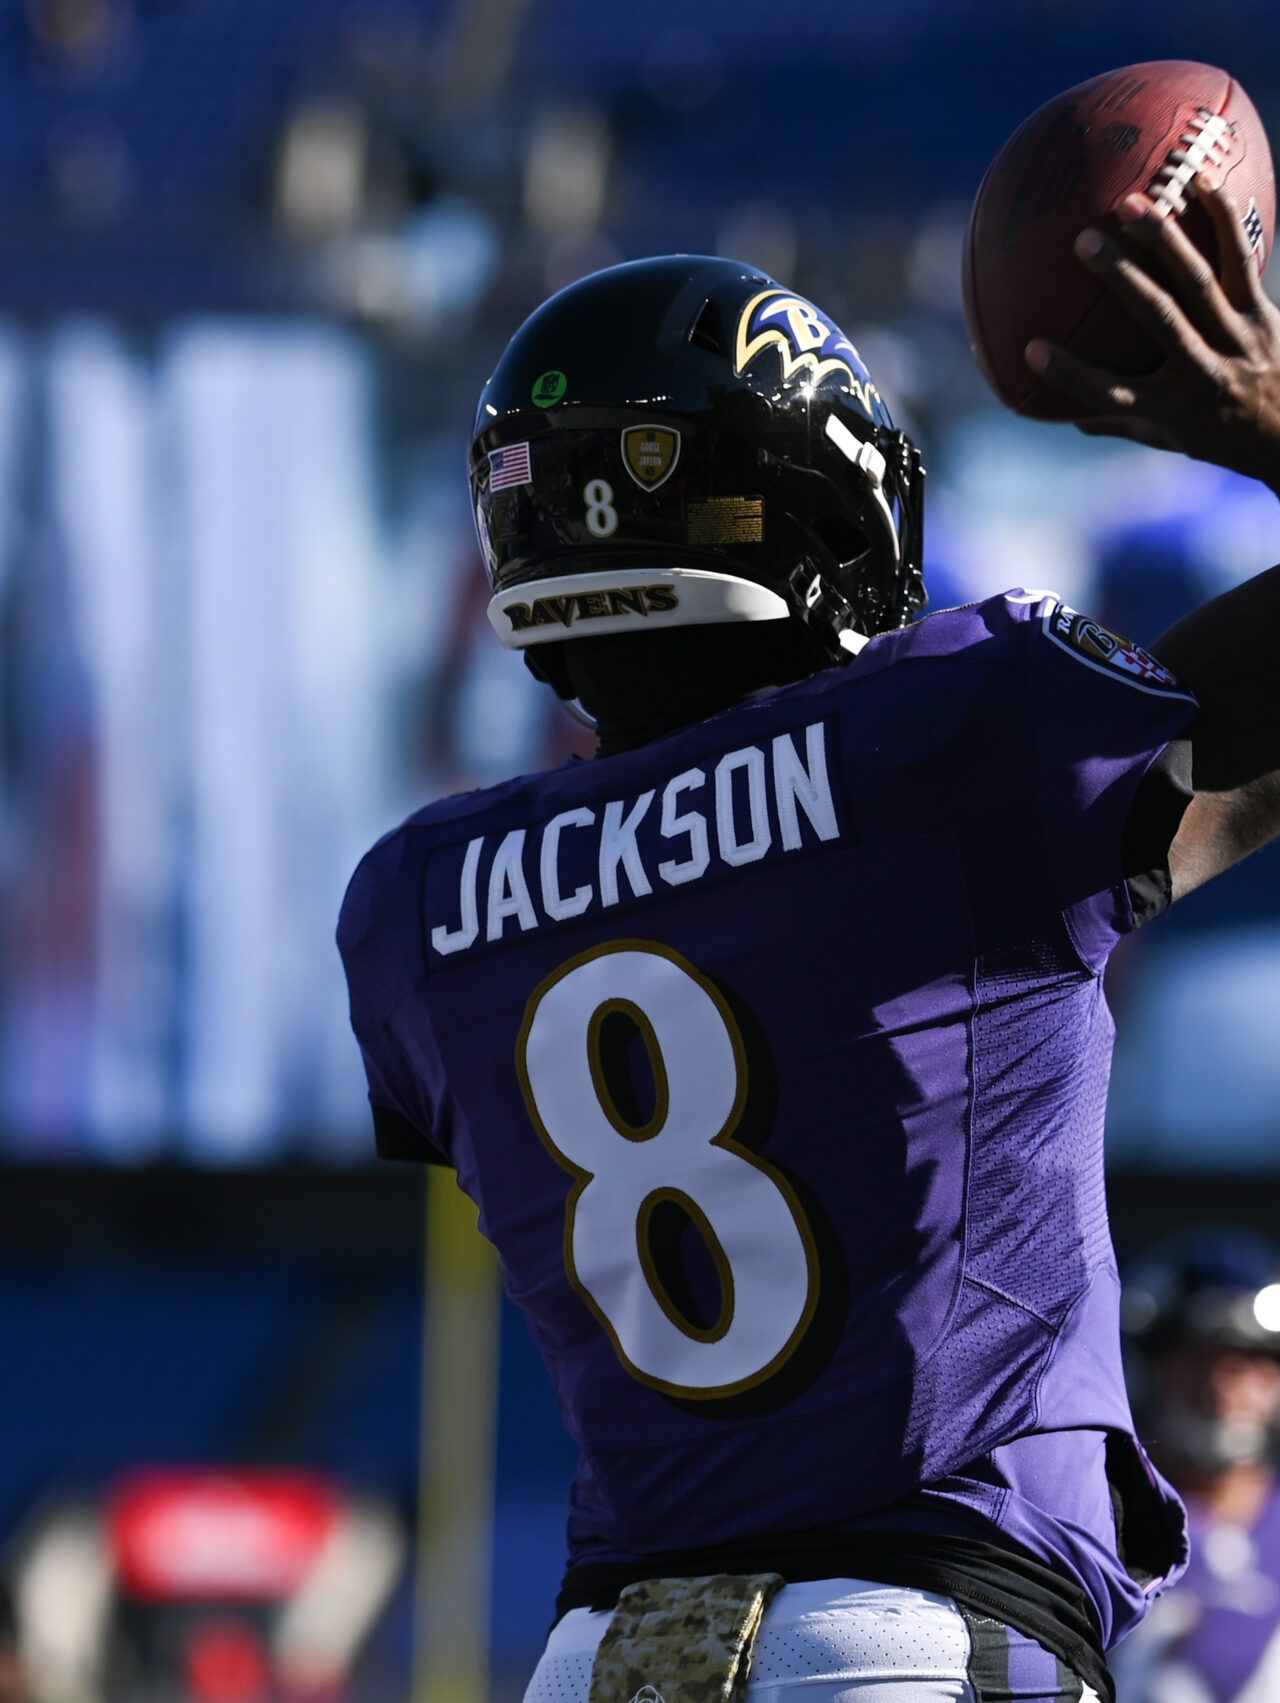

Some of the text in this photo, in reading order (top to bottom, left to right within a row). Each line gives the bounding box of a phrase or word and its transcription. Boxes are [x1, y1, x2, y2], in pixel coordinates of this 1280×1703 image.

[584, 479, 619, 537] 8
[503, 584, 680, 631] RAVENS
[431, 721, 840, 956] JACKSON
[515, 938, 819, 1400] 8
